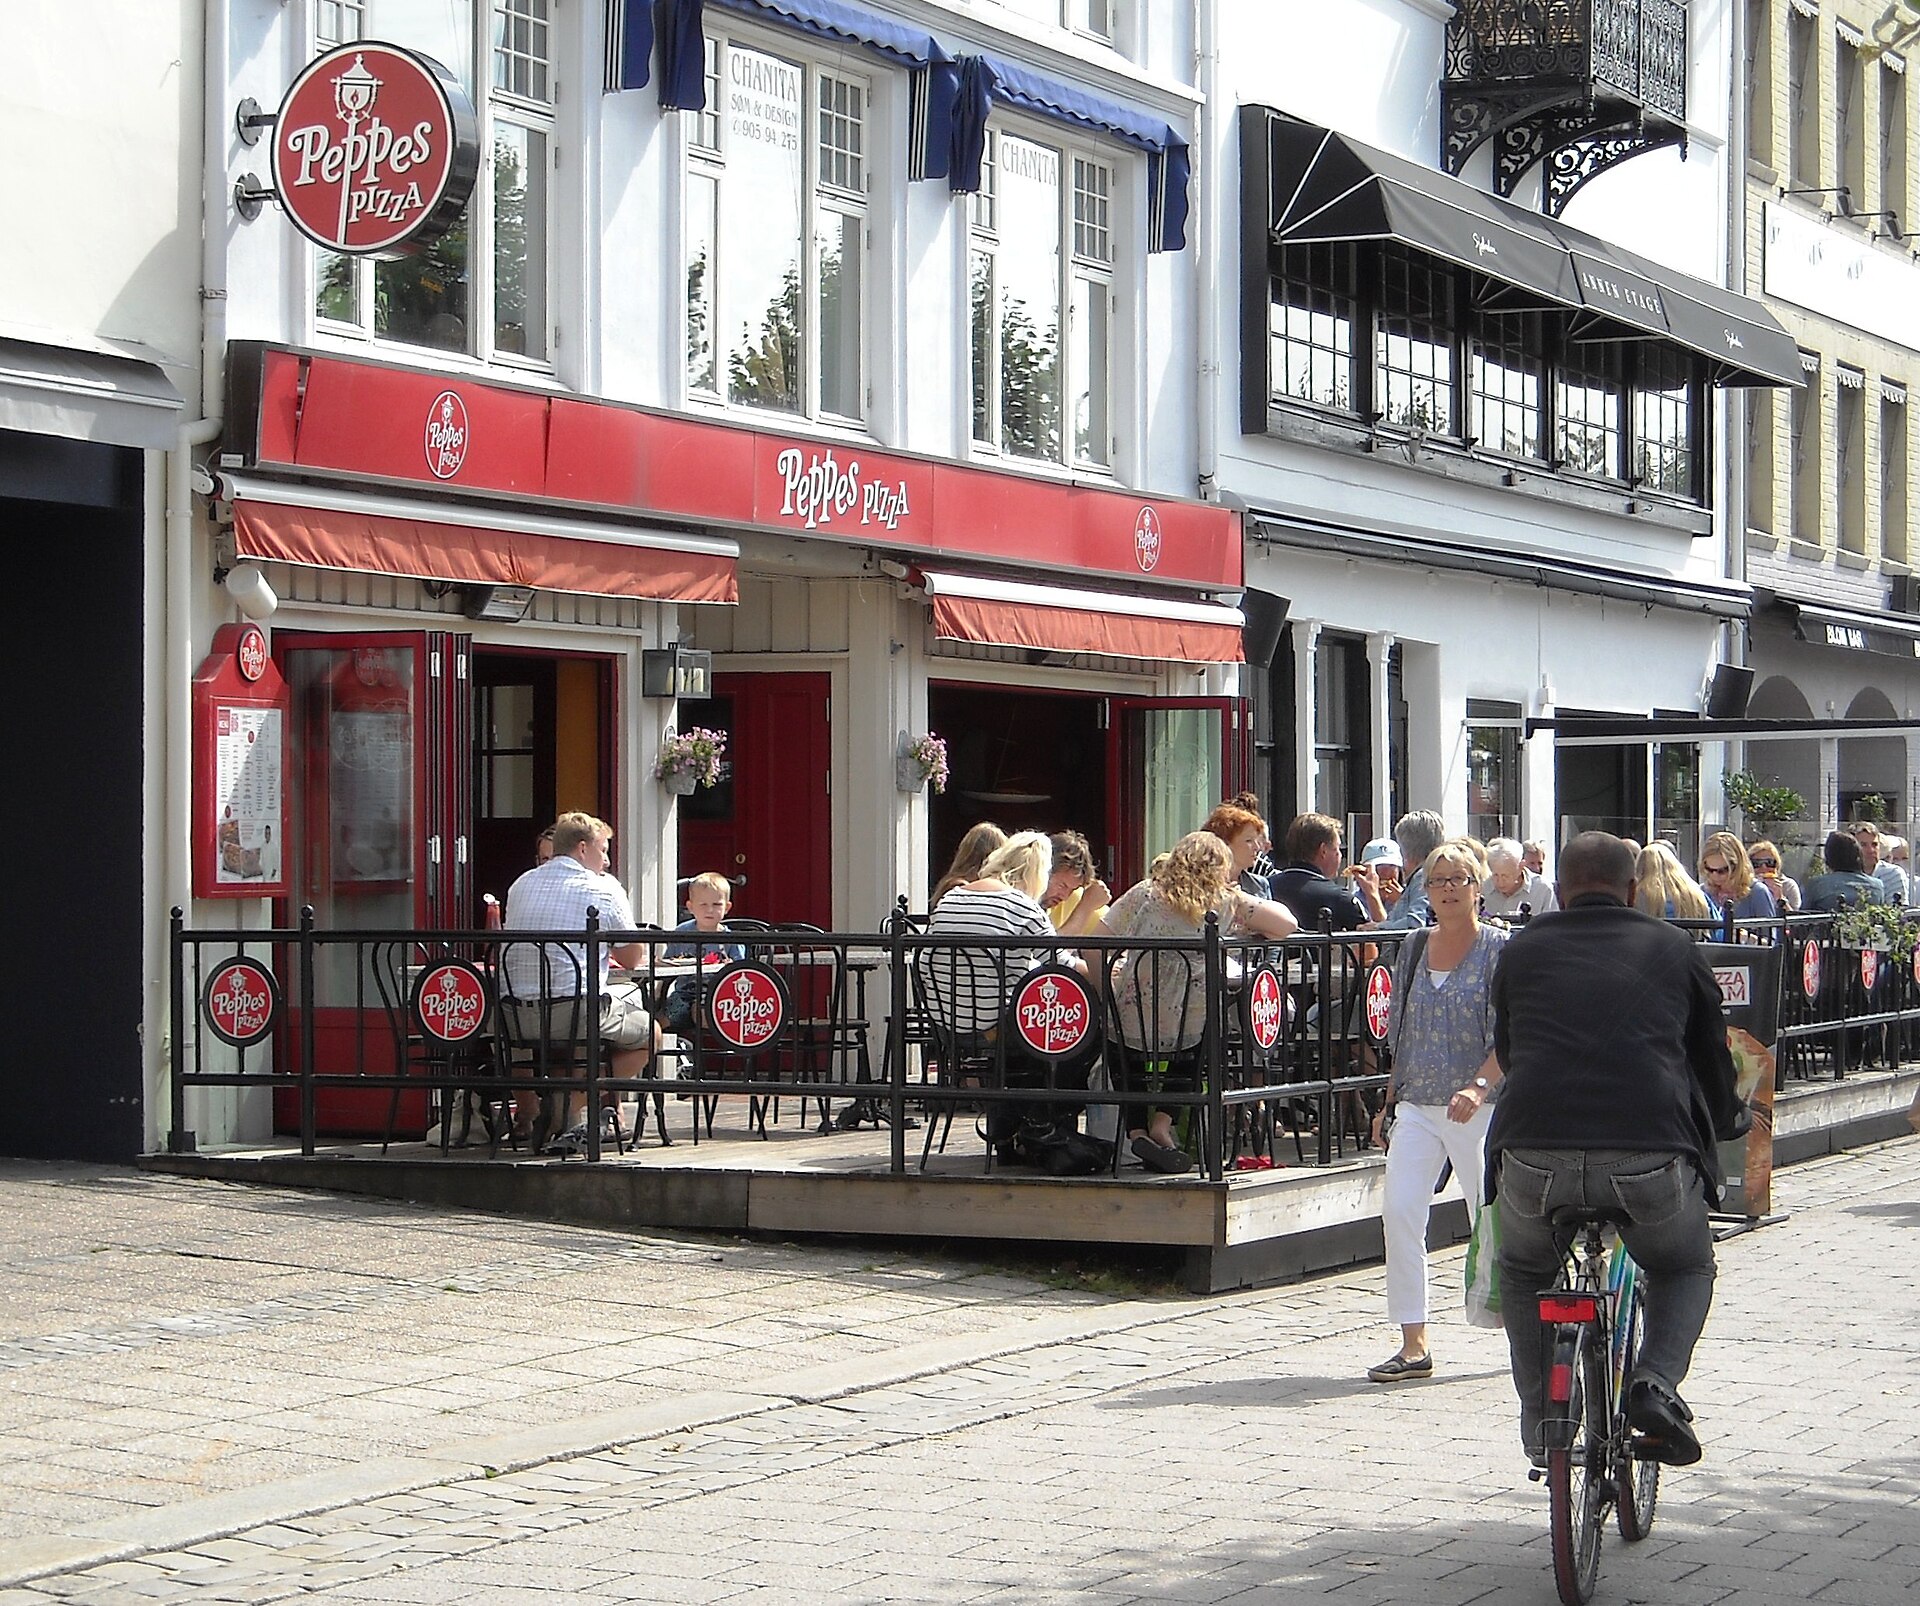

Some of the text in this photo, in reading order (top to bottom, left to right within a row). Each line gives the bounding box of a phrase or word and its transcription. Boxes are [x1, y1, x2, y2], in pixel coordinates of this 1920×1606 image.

[731, 53, 797, 102] CHANITA
[754, 101, 762, 117] &
[765, 103, 797, 128] DESIGN
[742, 120, 761, 139] 905
[287, 117, 433, 187] Peppes
[1001, 142, 1057, 187] CHANITA
[347, 182, 424, 223] PIZZA
[1581, 272, 1661, 314] ANNEN ETAGE
[429, 422, 464, 450] Peppes
[777, 449, 910, 530] Peppes PIZZA
[1713, 971, 1745, 986] ZZA
[213, 990, 266, 1016] Peppes
[423, 991, 478, 1017] Peppes
[717, 995, 774, 1022] Peppes
[1021, 1001, 1081, 1029] Peppes
[237, 1013, 263, 1029] PIZZA
[447, 1014, 475, 1031] PIZZA
[743, 1019, 772, 1036] PIZZA
[1049, 1025, 1079, 1043] PIZZA
